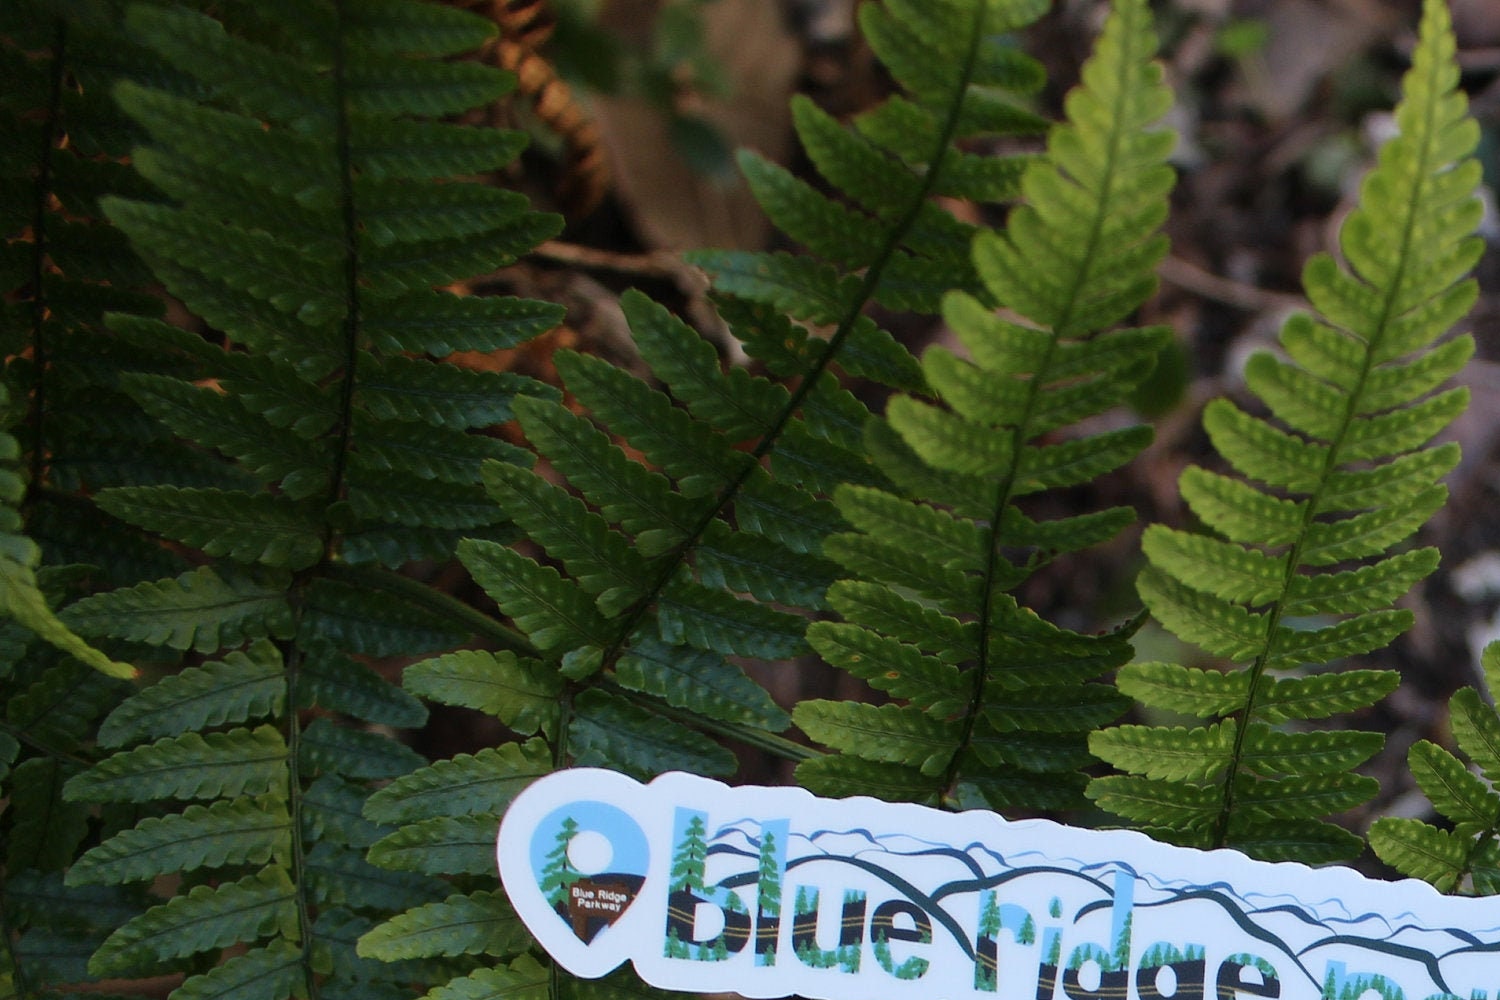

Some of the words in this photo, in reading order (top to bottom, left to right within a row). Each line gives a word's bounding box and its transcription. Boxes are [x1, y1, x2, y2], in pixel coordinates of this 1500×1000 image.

[572, 886, 595, 898] Blue
[598, 889, 627, 902] Ridge
[664, 806, 933, 981] blue
[577, 898, 621, 912] Parkway
